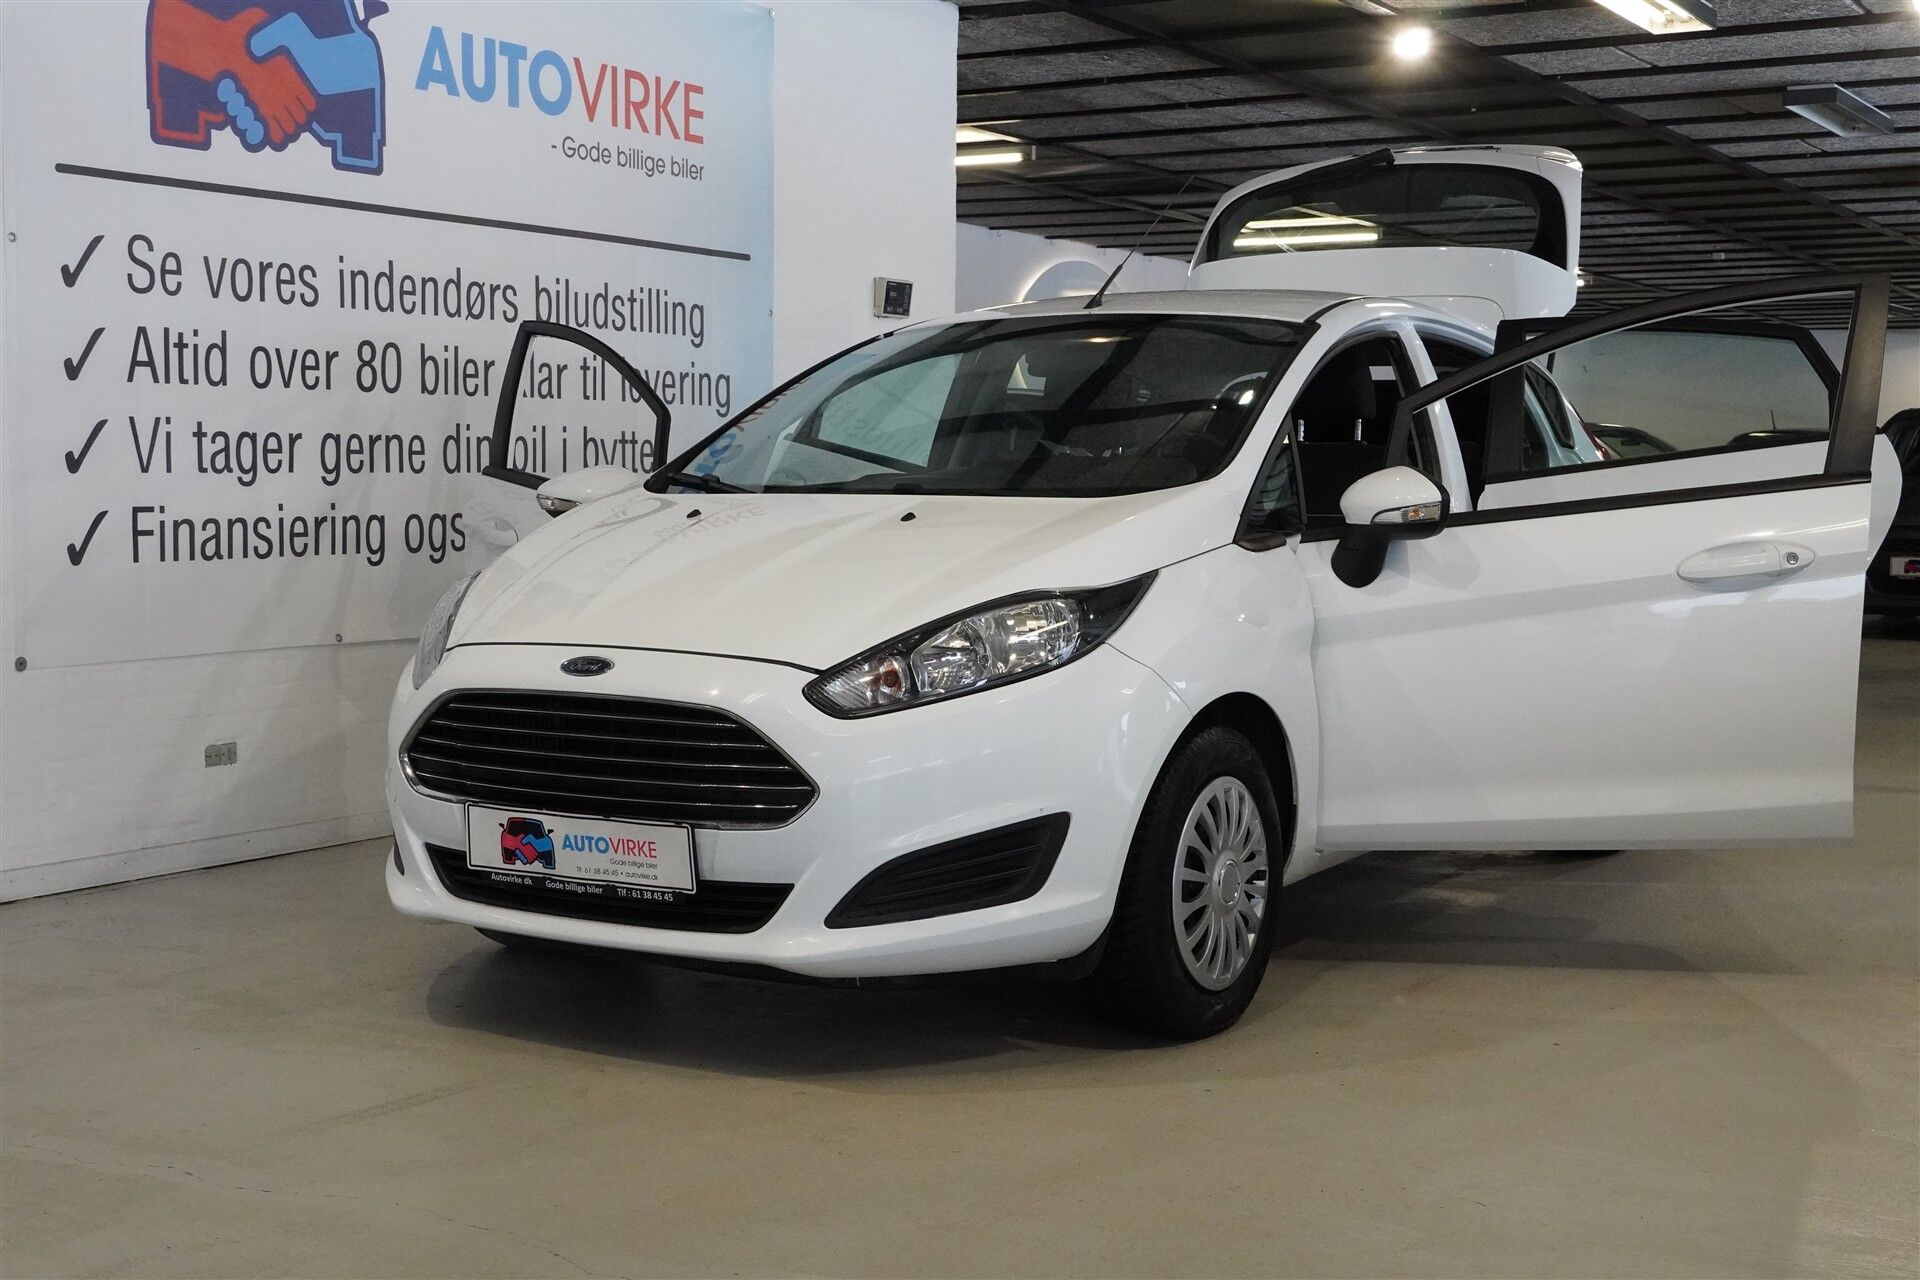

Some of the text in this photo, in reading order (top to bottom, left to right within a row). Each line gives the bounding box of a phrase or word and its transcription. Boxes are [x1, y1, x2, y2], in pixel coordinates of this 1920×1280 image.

[415, 25, 704, 145] AUTOVIRKE
[562, 136, 612, 165] Gode
[616, 148, 667, 178] billige
[671, 156, 704, 181] biler
[127, 234, 705, 349] Se vores indendørs biludstilling
[127, 326, 228, 388] Altid
[250, 346, 339, 391] over
[356, 340, 402, 394] 80
[420, 343, 496, 397] biler
[521, 350, 568, 400] lar
[580, 354, 606, 401] til
[128, 416, 173, 473] Vi
[192, 421, 303, 487] tager
[320, 432, 426, 486] gerne
[443, 423, 492, 474] din
[562, 426, 567, 473] i
[132, 503, 386, 567] Finansiering
[561, 834, 658, 858] AUTOVIRKE
[491, 873, 533, 886] Autovirke dk
[609, 858, 627, 867] Gode
[627, 860, 645, 870] billige
[612, 869, 619, 877] 45
[545, 880, 603, 895] Gode billige biler
[632, 889, 641, 899] 61
[642, 890, 652, 900] 38
[653, 892, 663, 901] 45
[663, 893, 673, 902] 45
